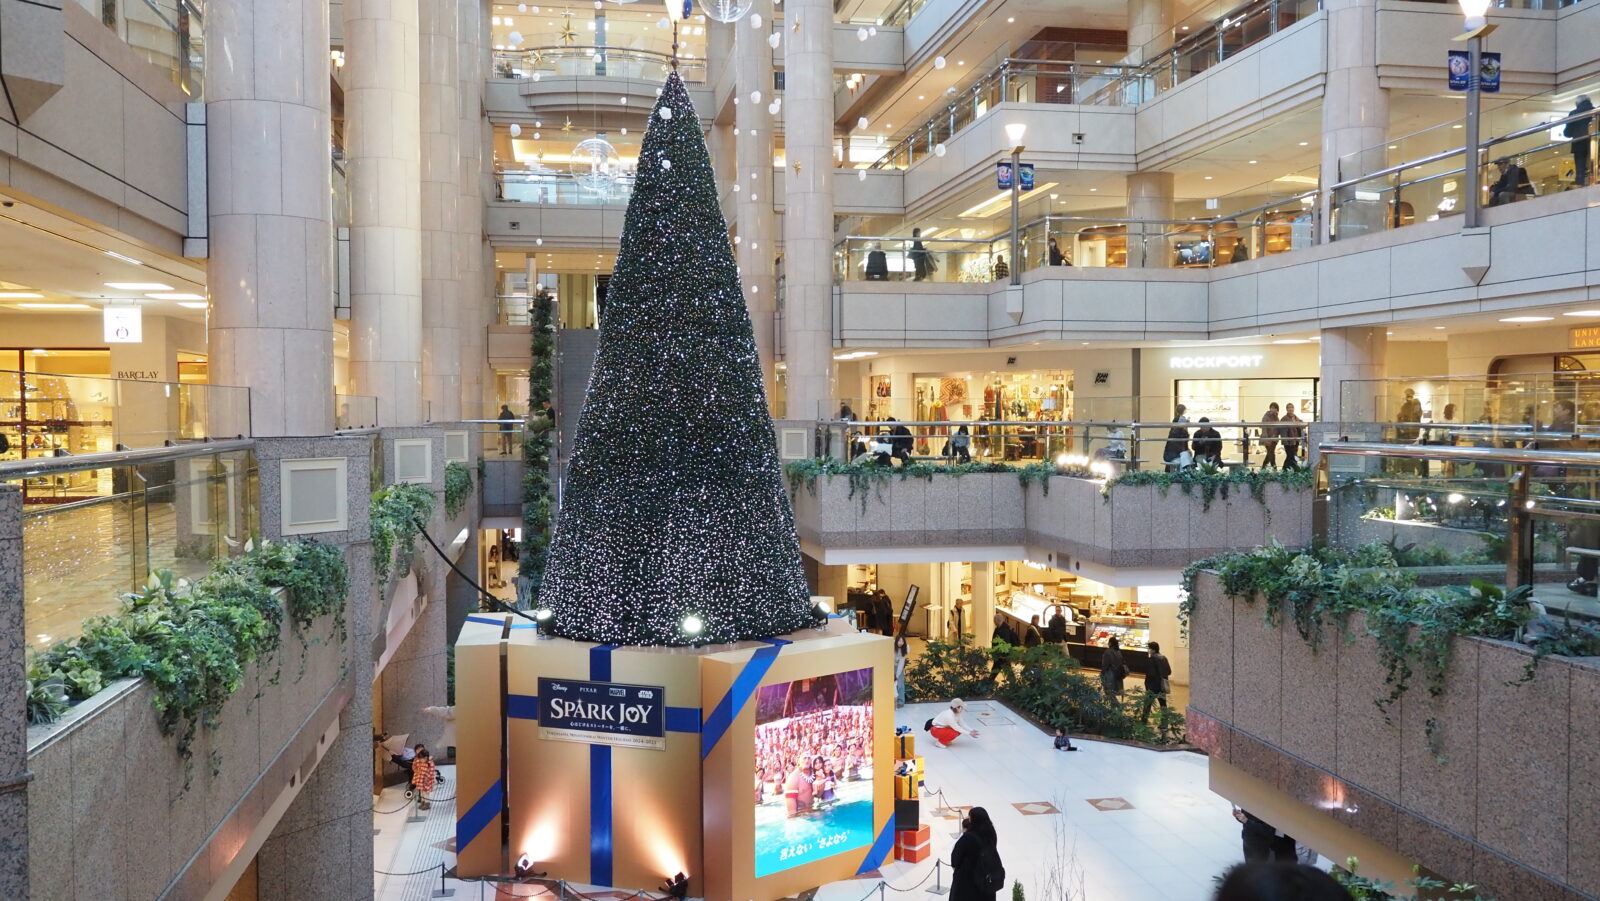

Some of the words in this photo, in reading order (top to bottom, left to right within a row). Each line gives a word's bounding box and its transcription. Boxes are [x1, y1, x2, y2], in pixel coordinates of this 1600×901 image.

[1170, 355, 1263, 369] ROCKPORT
[118, 371, 159, 380] BARCLAY
[551, 683, 568, 692] Disney
[609, 688, 626, 697] MARVEL
[550, 697, 615, 721] SPARK
[619, 703, 653, 724] JOY
[780, 843, 812, 861] 言えない
